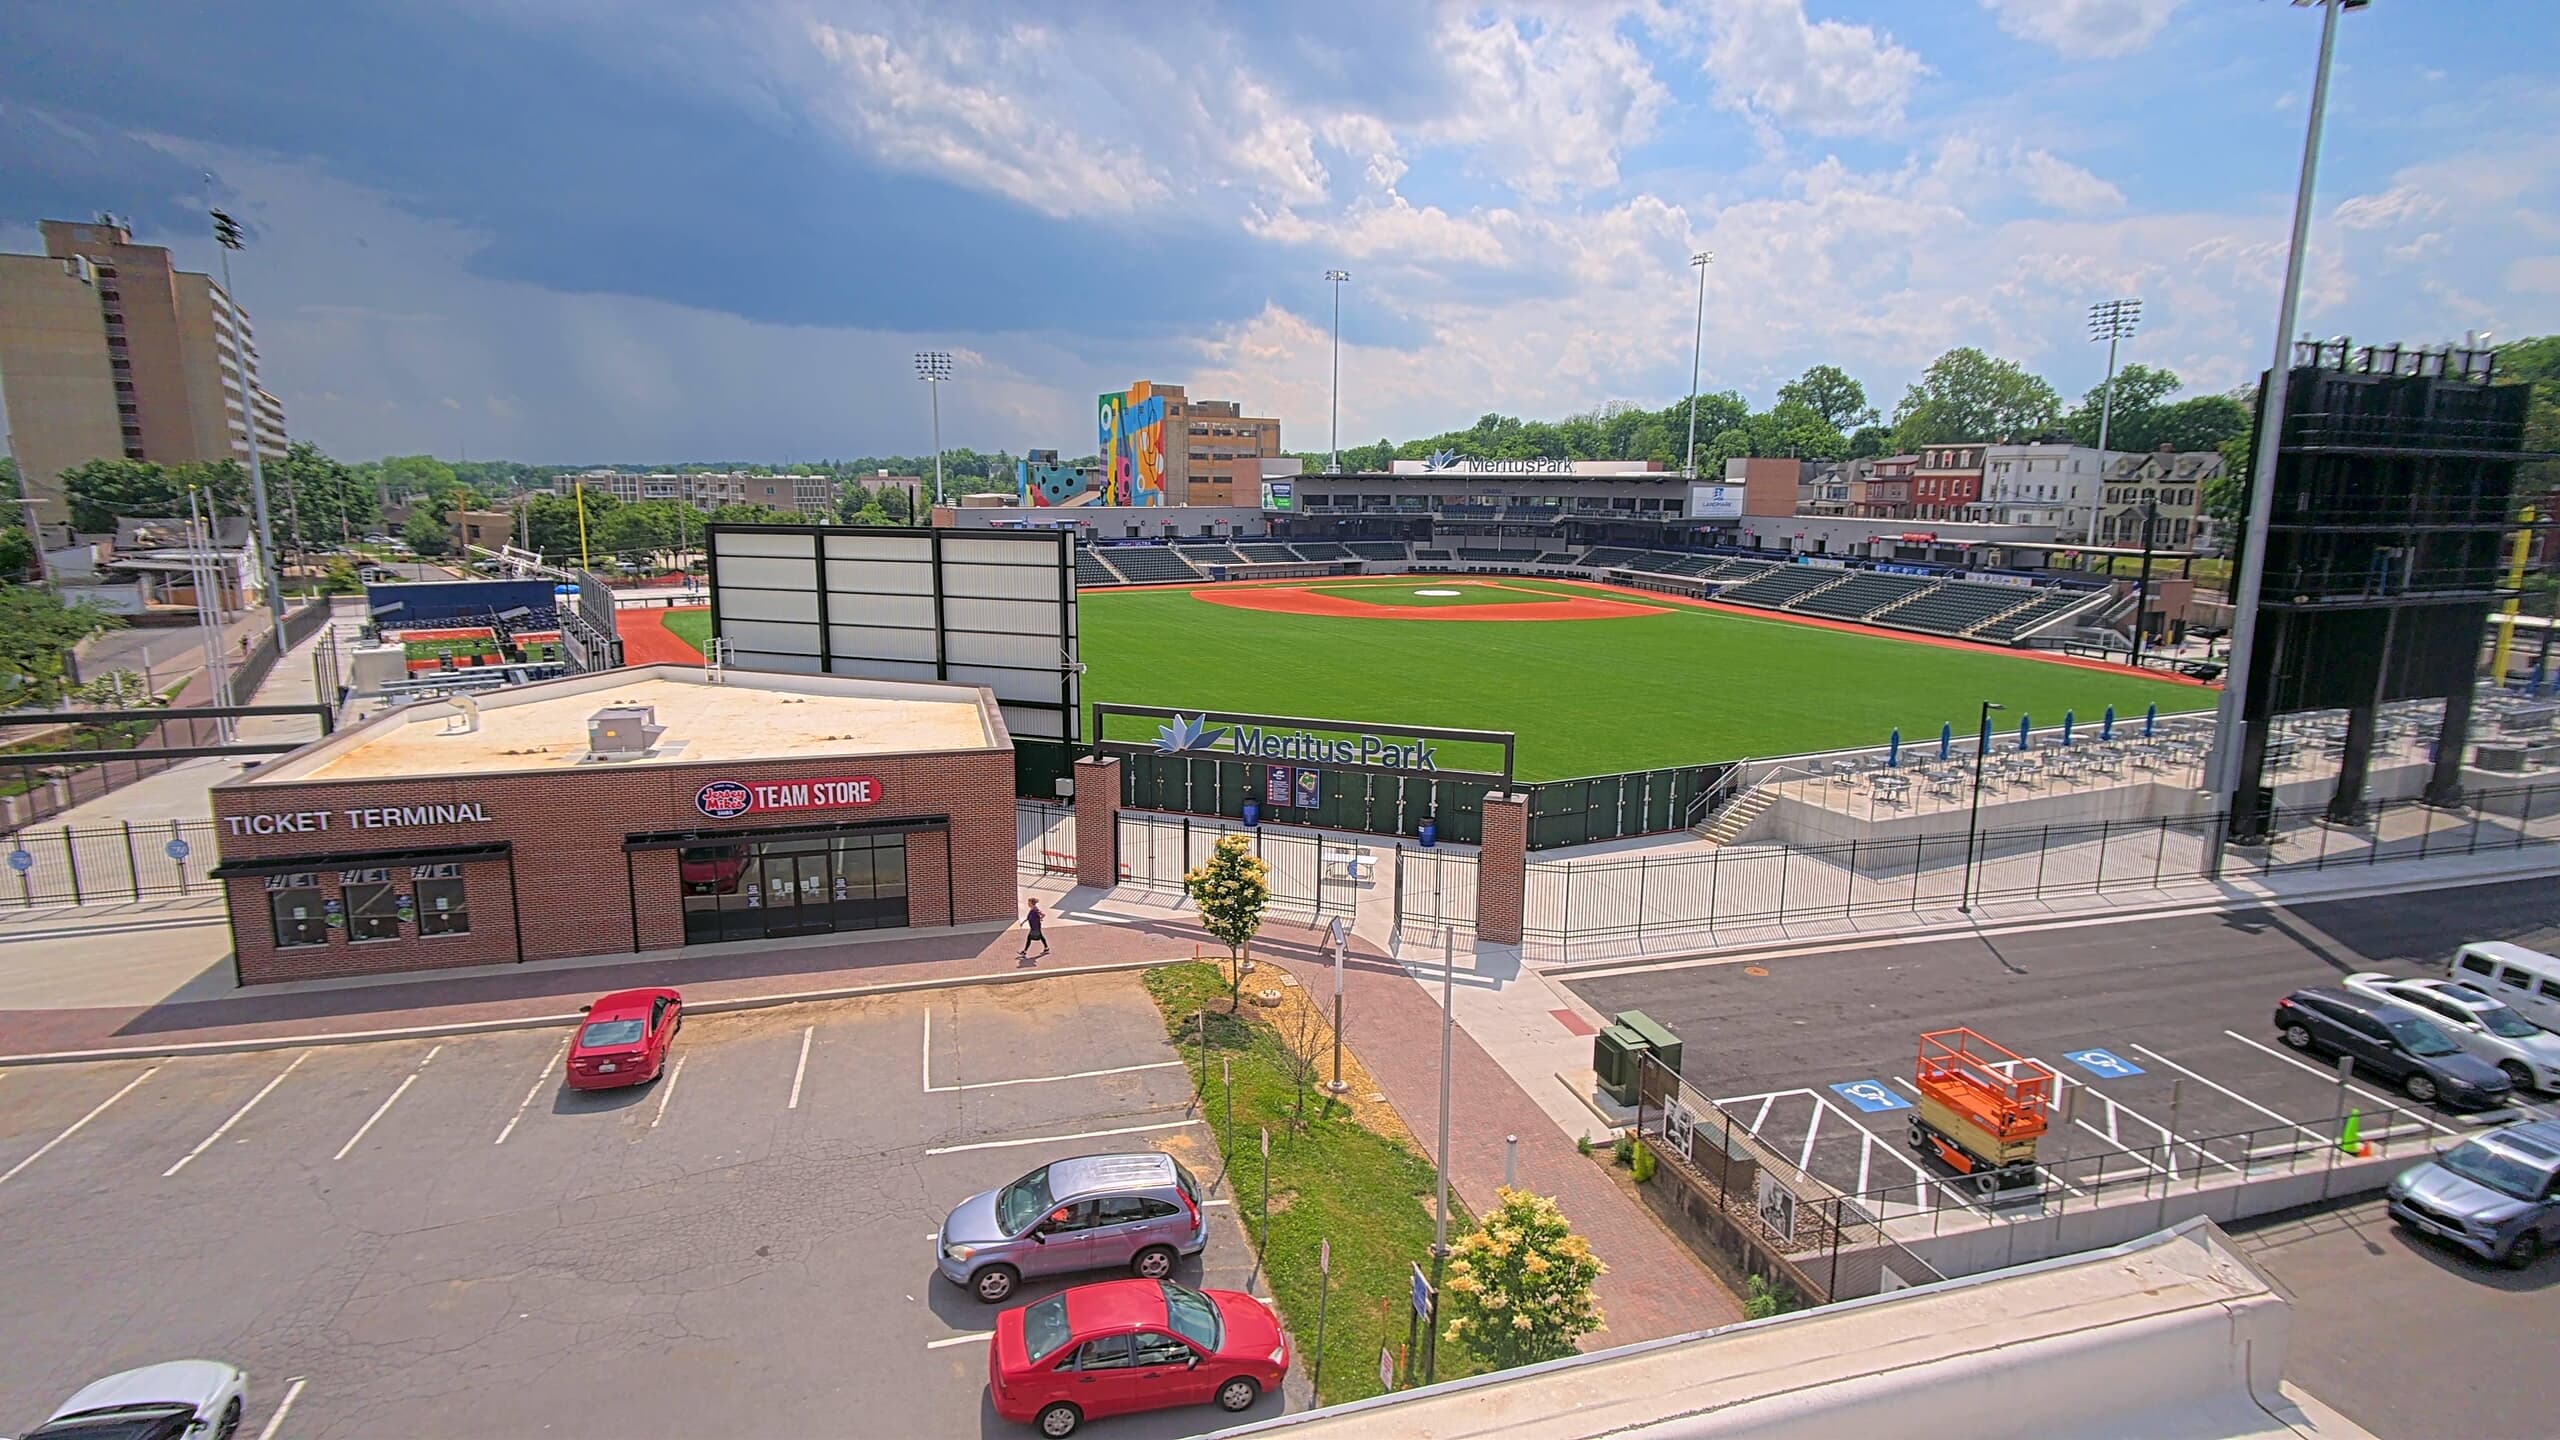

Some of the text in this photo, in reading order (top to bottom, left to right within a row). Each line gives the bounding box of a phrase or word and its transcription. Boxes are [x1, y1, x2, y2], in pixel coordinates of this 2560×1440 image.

[1468, 456, 1577, 475] Meritus Park
[1233, 725, 1437, 772] Meritus Park
[703, 788, 747, 801] Jersey
[755, 781, 872, 809] TEAM STORE
[224, 803, 492, 836] TICKET TERMINAL
